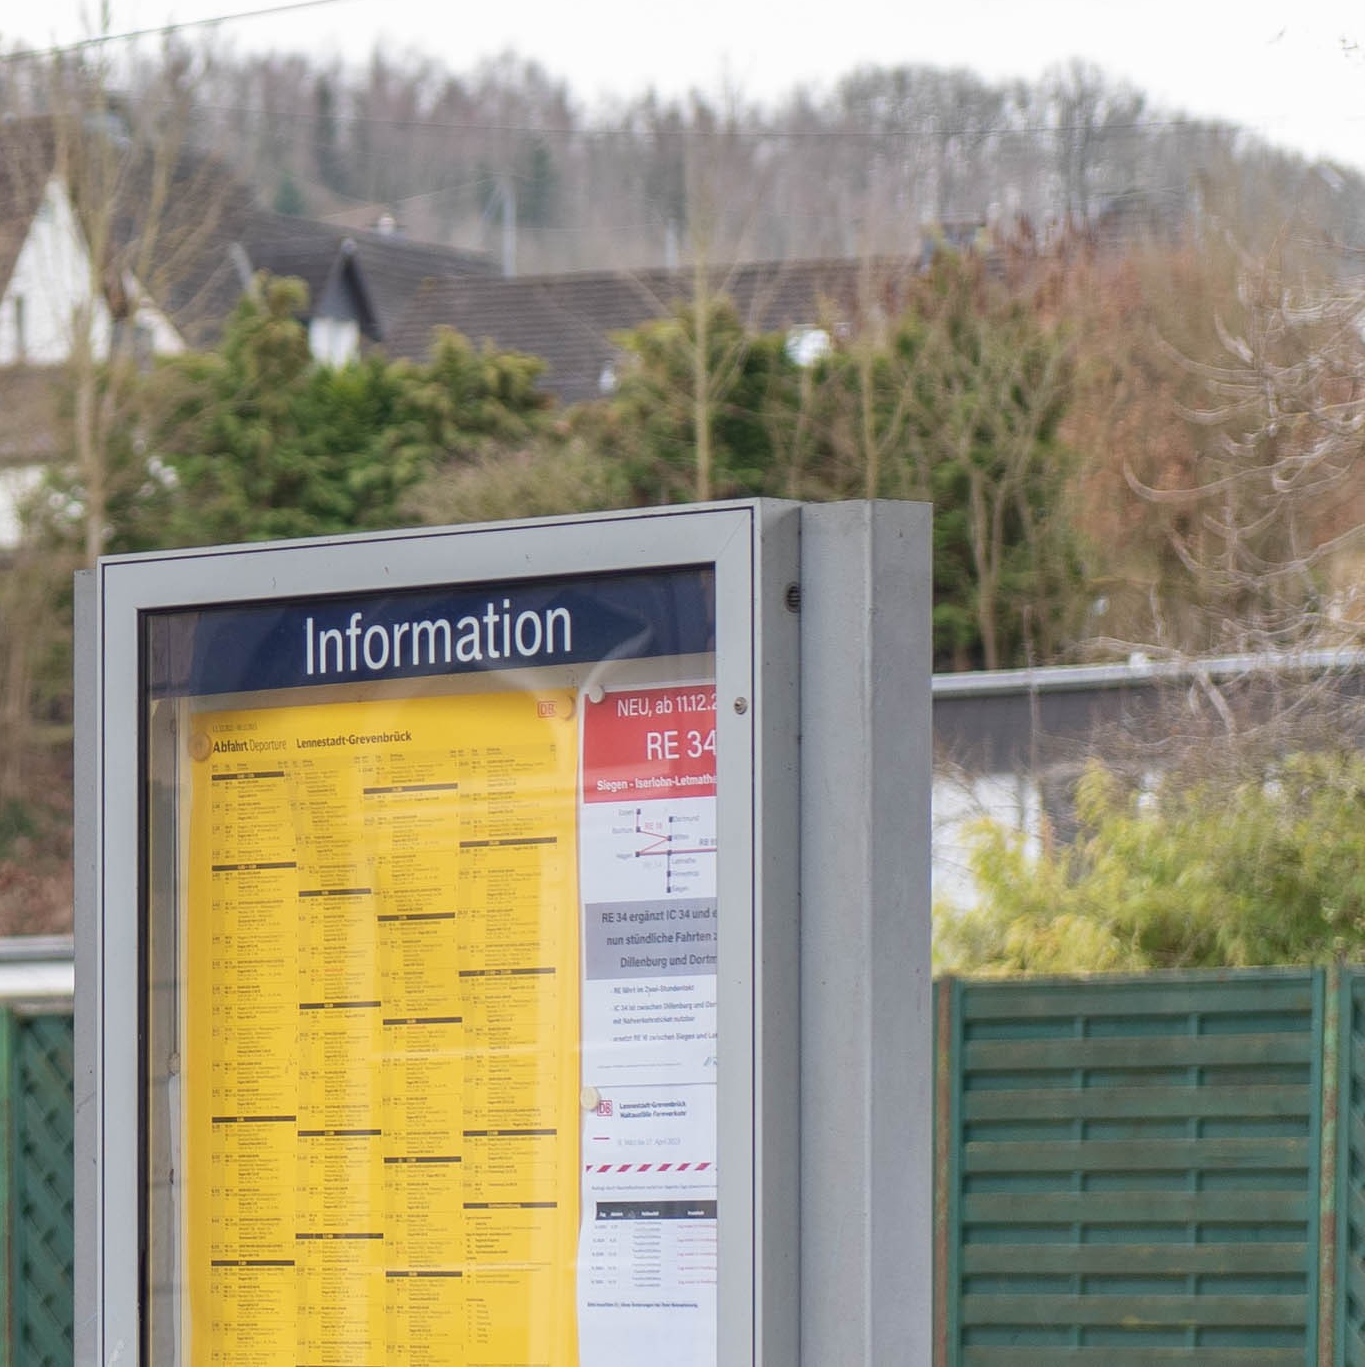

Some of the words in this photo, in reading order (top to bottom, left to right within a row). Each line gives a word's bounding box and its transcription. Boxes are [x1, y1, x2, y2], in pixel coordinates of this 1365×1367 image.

[305, 599, 572, 675] Information
[538, 701, 556, 718] DB
[617, 698, 652, 718] NEU,
[655, 696, 673, 714] ab
[212, 740, 249, 754] Abfahrt
[250, 739, 287, 752] Departure
[296, 731, 412, 749] Lennestadt-Grevenbrück
[646, 731, 680, 760] RE
[687, 729, 717, 759] 34
[597, 778, 629, 793] Siegen
[602, 912, 614, 923] RE
[616, 912, 628, 922] 34
[629, 910, 665, 924] ergänzt
[666, 909, 677, 920] IC
[679, 909, 690, 919] 34
[692, 908, 710, 918] und
[606, 936, 624, 945] nun
[625, 933, 674, 945] stündliche
[675, 932, 712, 943] Fahrten
[620, 956, 668, 969] Dillenburg
[669, 954, 687, 966] und
